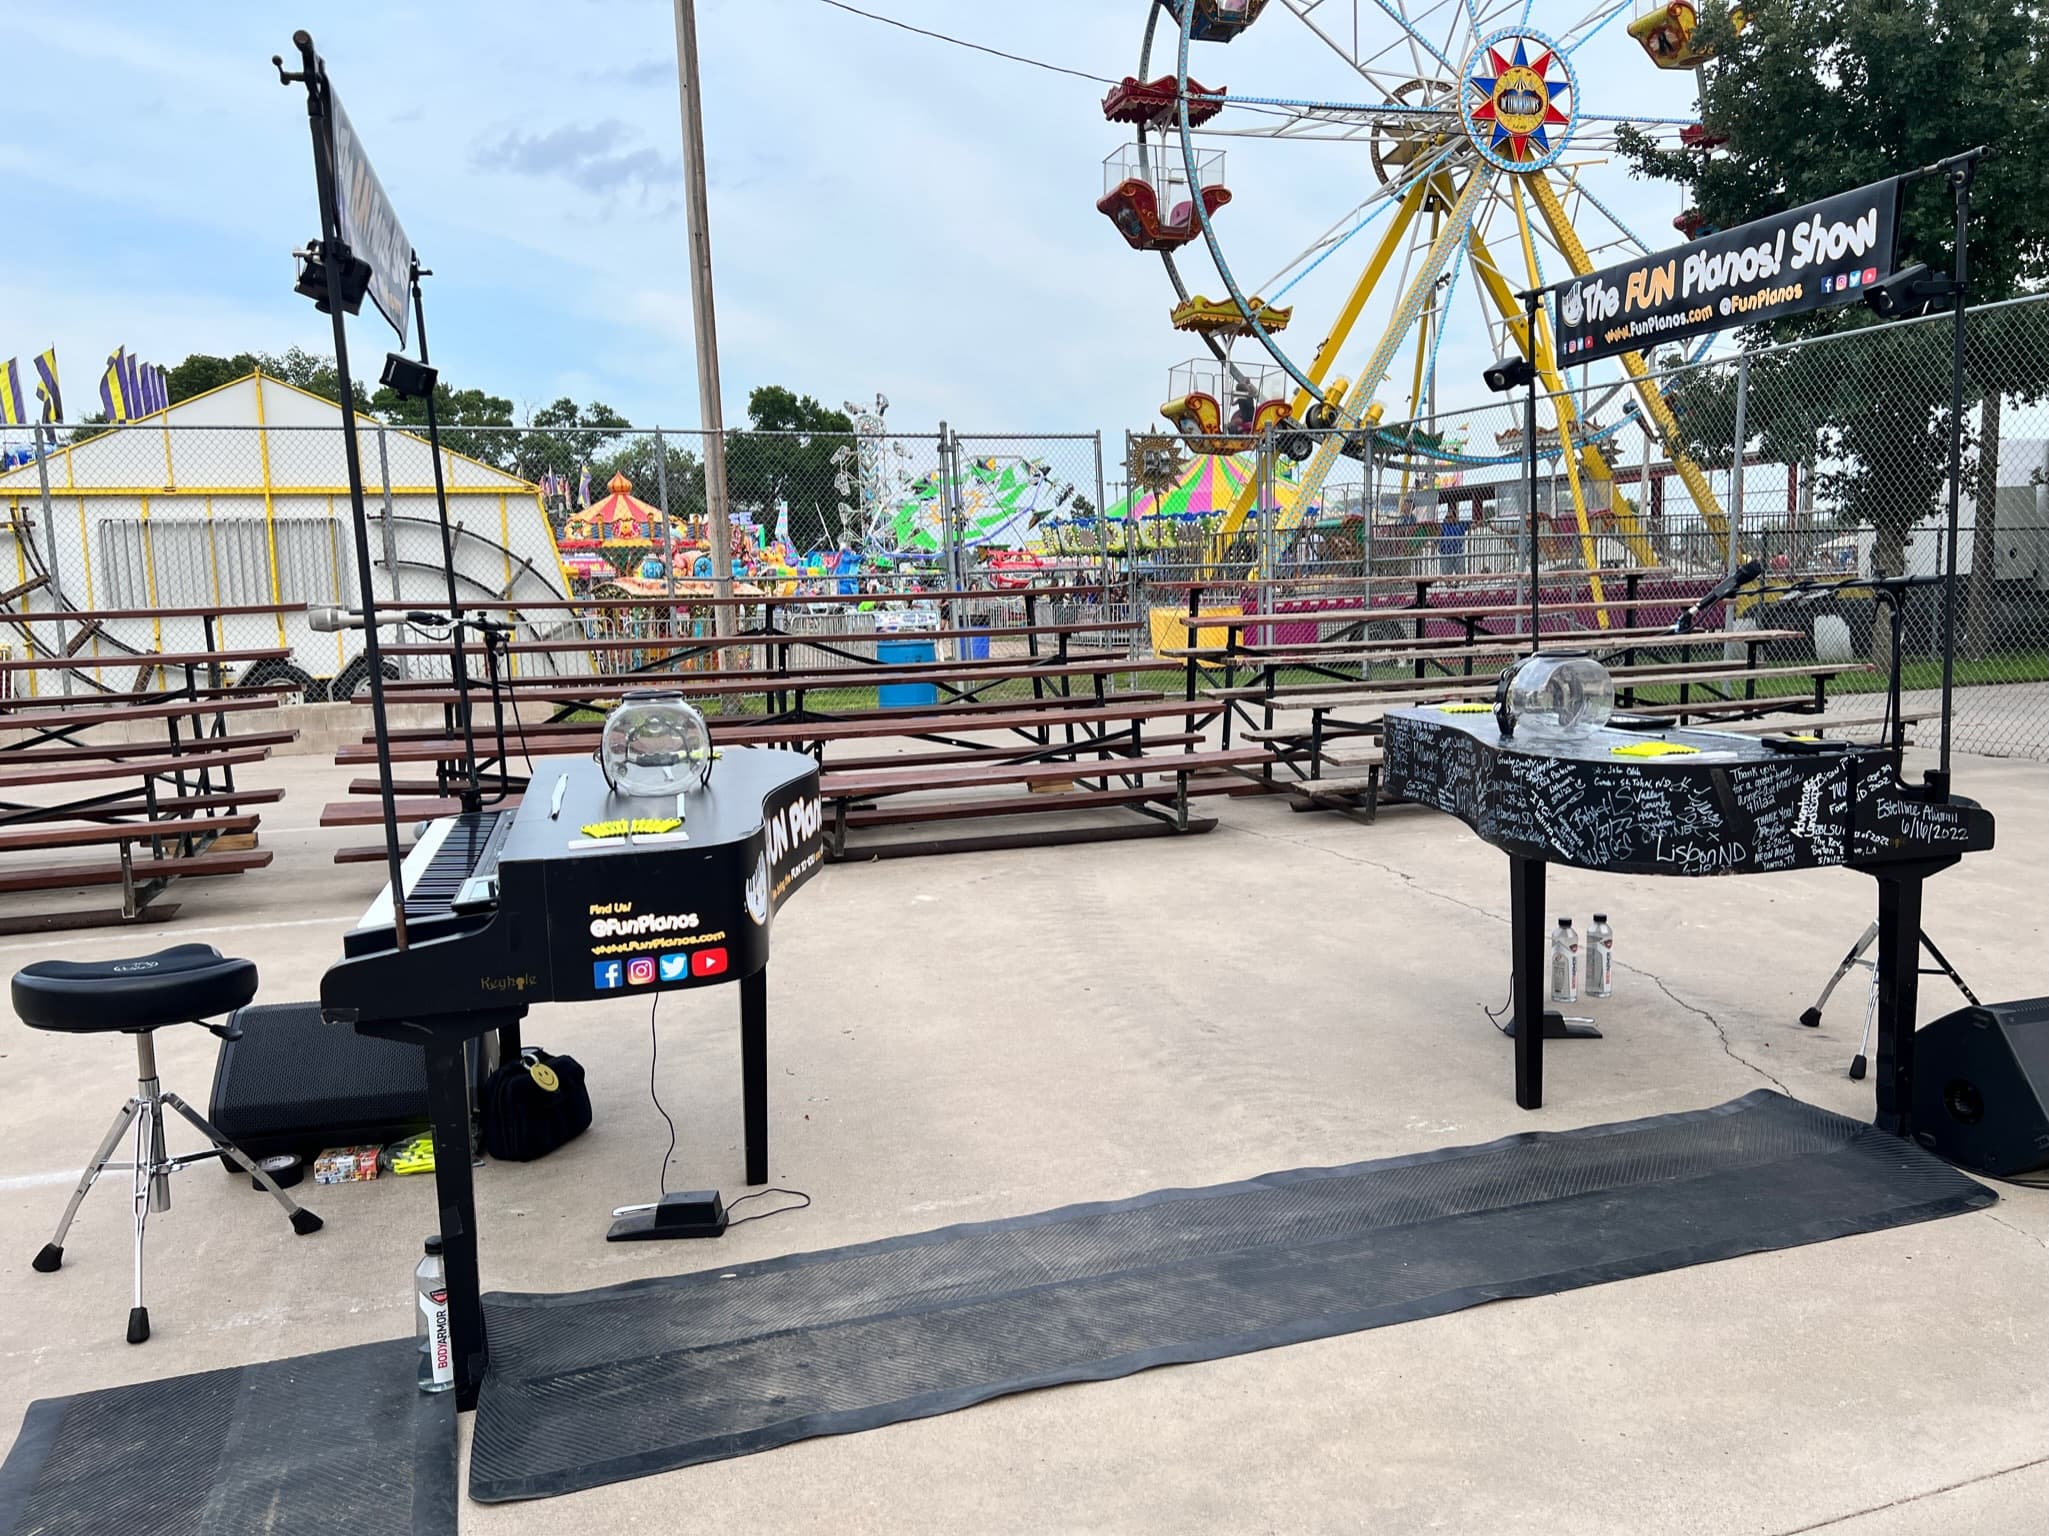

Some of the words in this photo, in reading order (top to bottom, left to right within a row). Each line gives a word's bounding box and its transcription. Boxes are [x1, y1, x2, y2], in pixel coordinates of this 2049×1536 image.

[1583, 279, 1620, 324] The
[1624, 258, 1676, 313] FUN
[1682, 228, 1786, 298] Pianos!
[1790, 207, 1878, 270] Show
[1603, 305, 1713, 344] www.FunPianos.com
[1719, 283, 1803, 317] @FunPianos
[1729, 766, 1759, 783] Thank
[1759, 764, 1776, 778] you
[1901, 818, 1969, 844] 6/16/2022
[1718, 841, 1747, 866] ND
[589, 903, 613, 915] Find
[614, 902, 632, 914] Us!
[589, 913, 700, 938] @FunPianos
[591, 931, 726, 955] www.FunPianos.com
[436, 1309, 449, 1369] BODYARMOR
